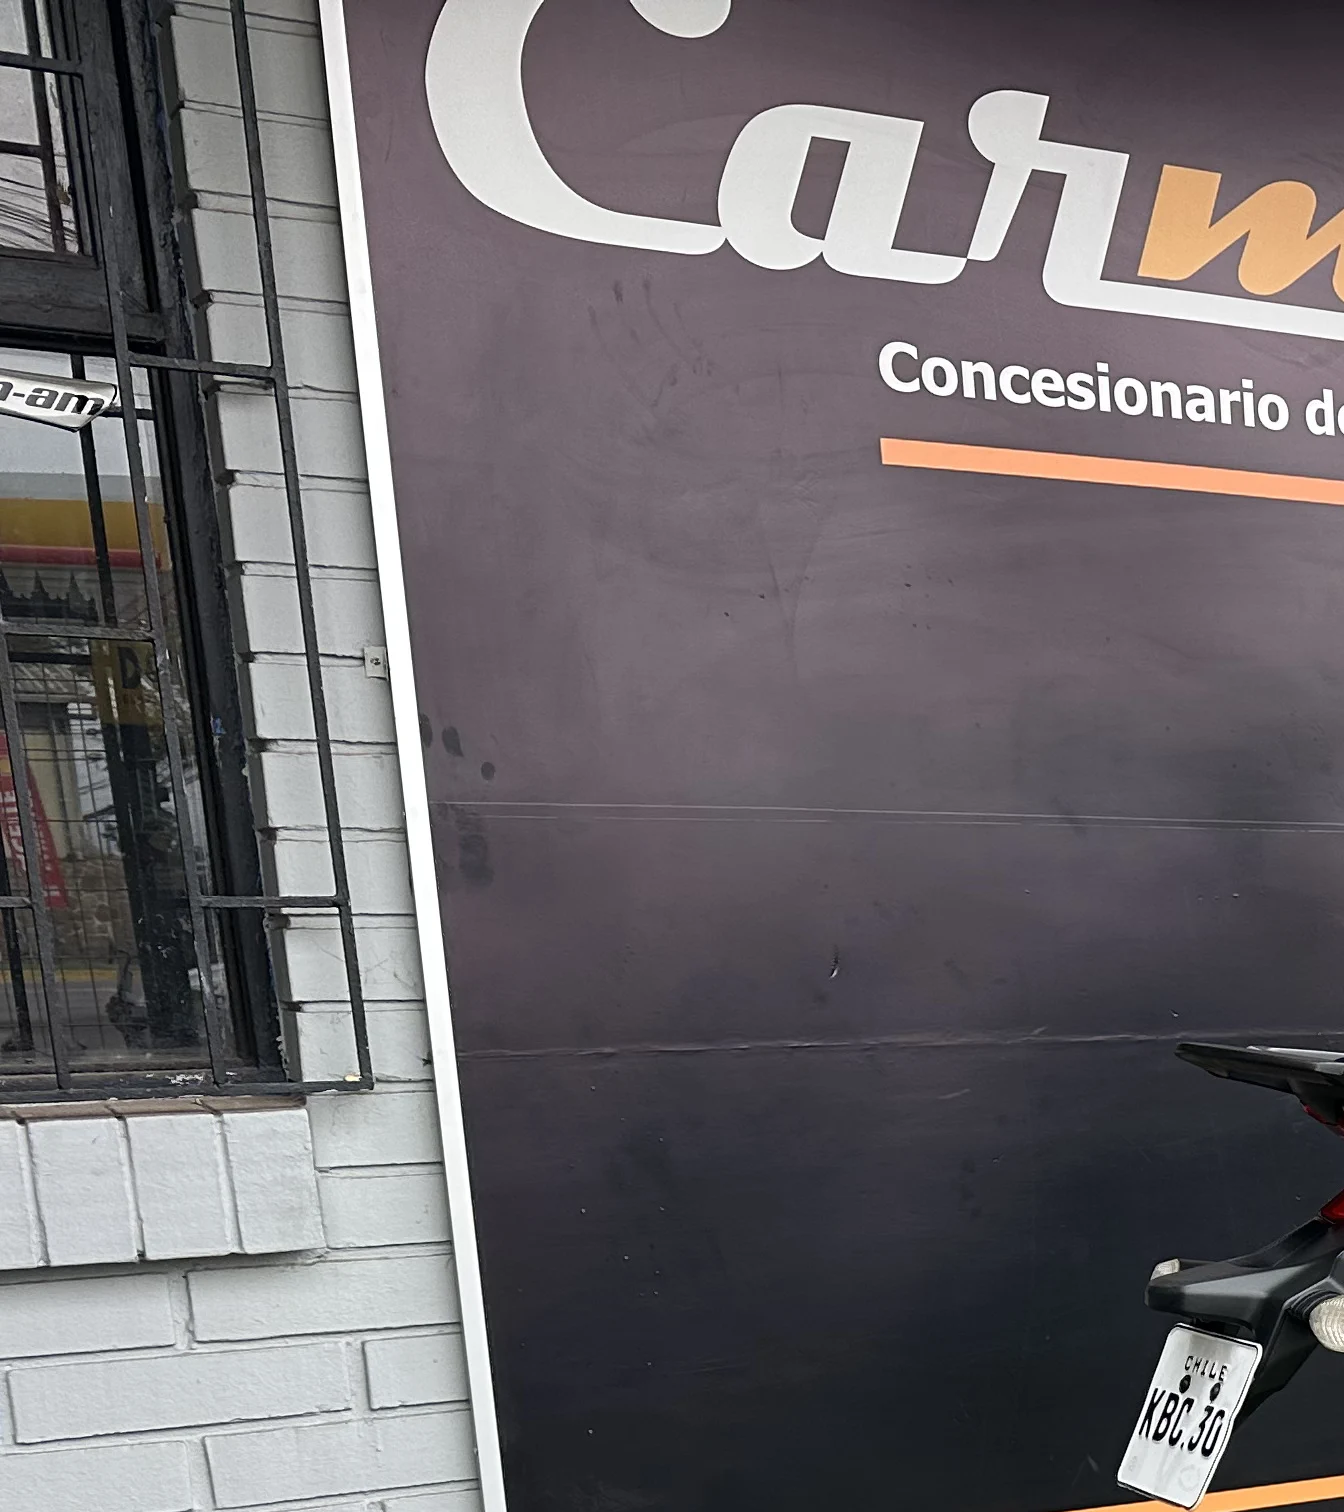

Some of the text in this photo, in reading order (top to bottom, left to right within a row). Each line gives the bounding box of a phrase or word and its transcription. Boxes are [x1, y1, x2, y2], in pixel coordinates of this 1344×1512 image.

[878, 340, 1290, 432] Concesionario
[1184, 1355, 1228, 1382] CHILE
[1138, 1387, 1226, 1458] KBC.30
